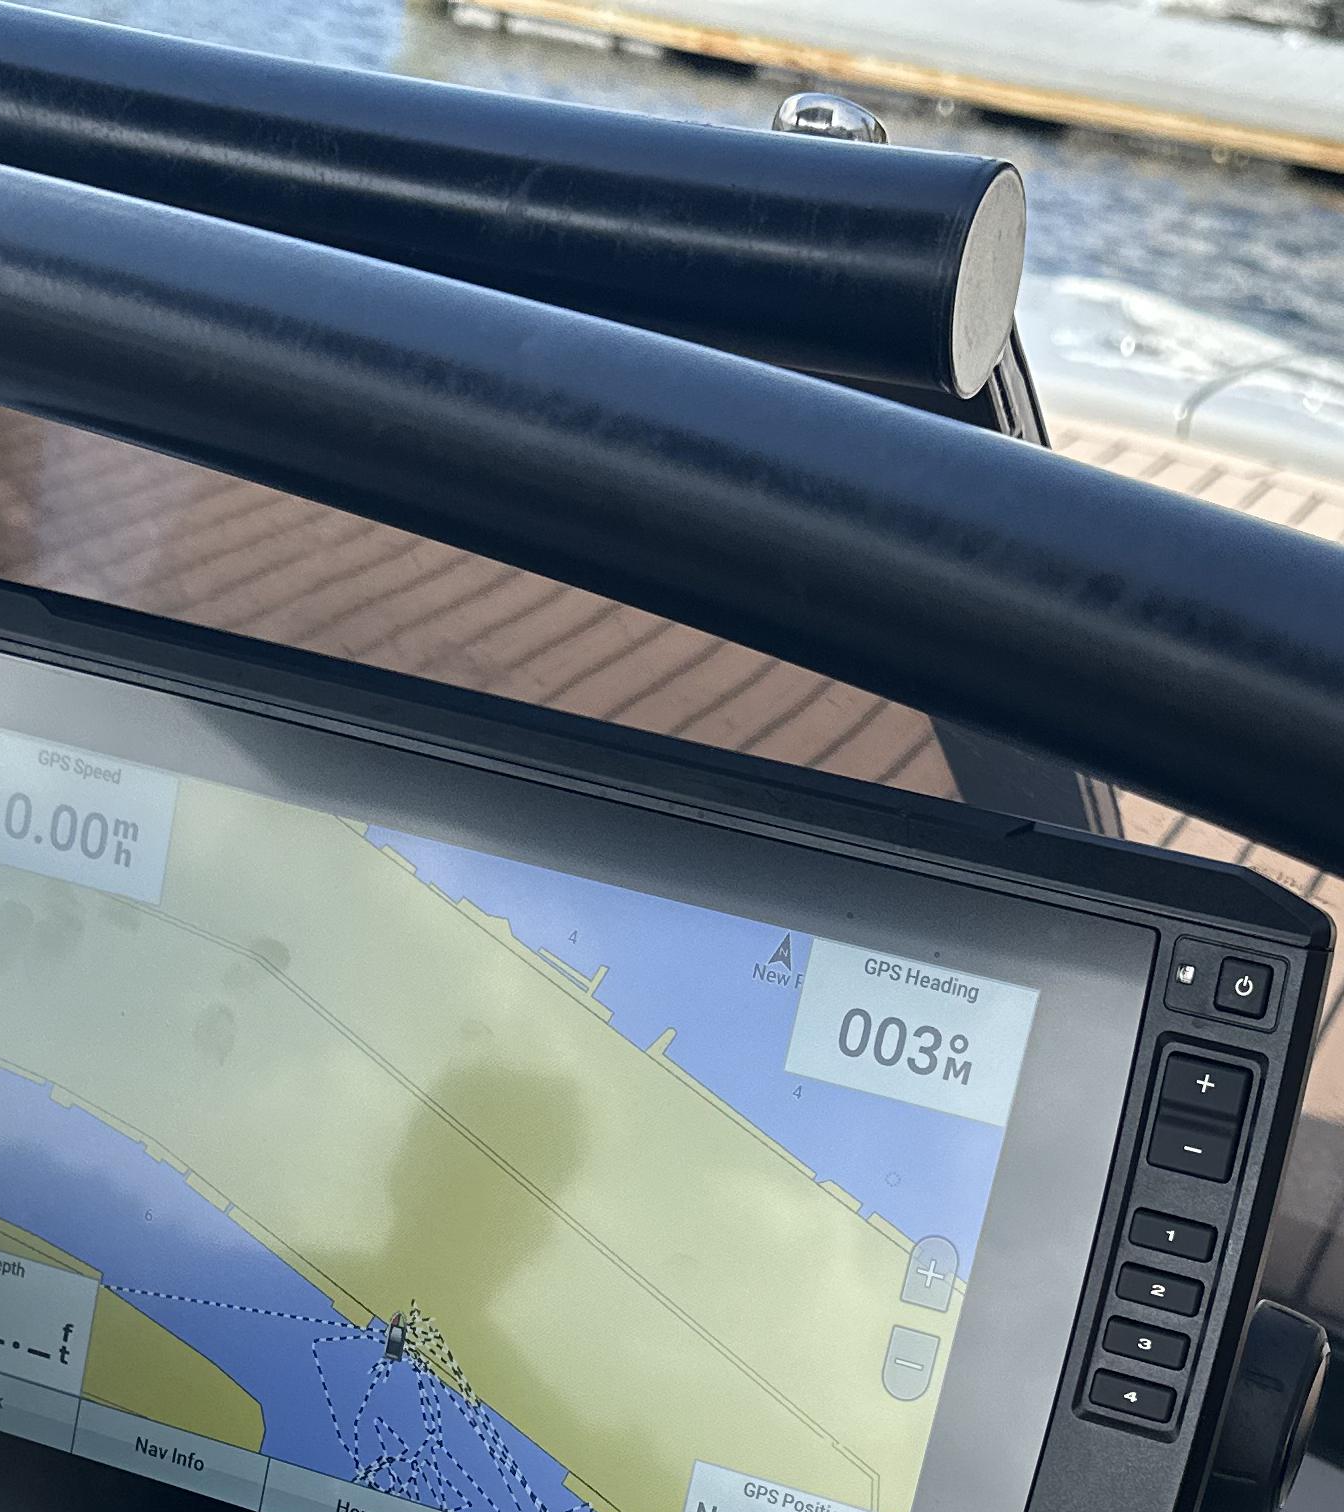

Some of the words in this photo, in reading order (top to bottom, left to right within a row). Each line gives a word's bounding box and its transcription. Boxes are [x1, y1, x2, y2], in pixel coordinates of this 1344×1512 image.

[37, 749, 71, 772] GPS
[73, 758, 122, 785] Speed
[5, 792, 108, 859] 0.00
[568, 930, 578, 944] 4
[752, 962, 791, 987] New
[864, 957, 901, 982] GPS
[905, 968, 979, 1004] Heading
[793, 1085, 803, 1100] 4
[144, 1208, 154, 1222] 6
[1165, 1229, 1176, 1242] 1
[1149, 1284, 1166, 1297] 2
[1136, 1337, 1152, 1350] 3
[1123, 1391, 1138, 1403] 4
[135, 1435, 170, 1462] Nav
[171, 1447, 206, 1473] Info
[743, 1481, 779, 1505] GPS
